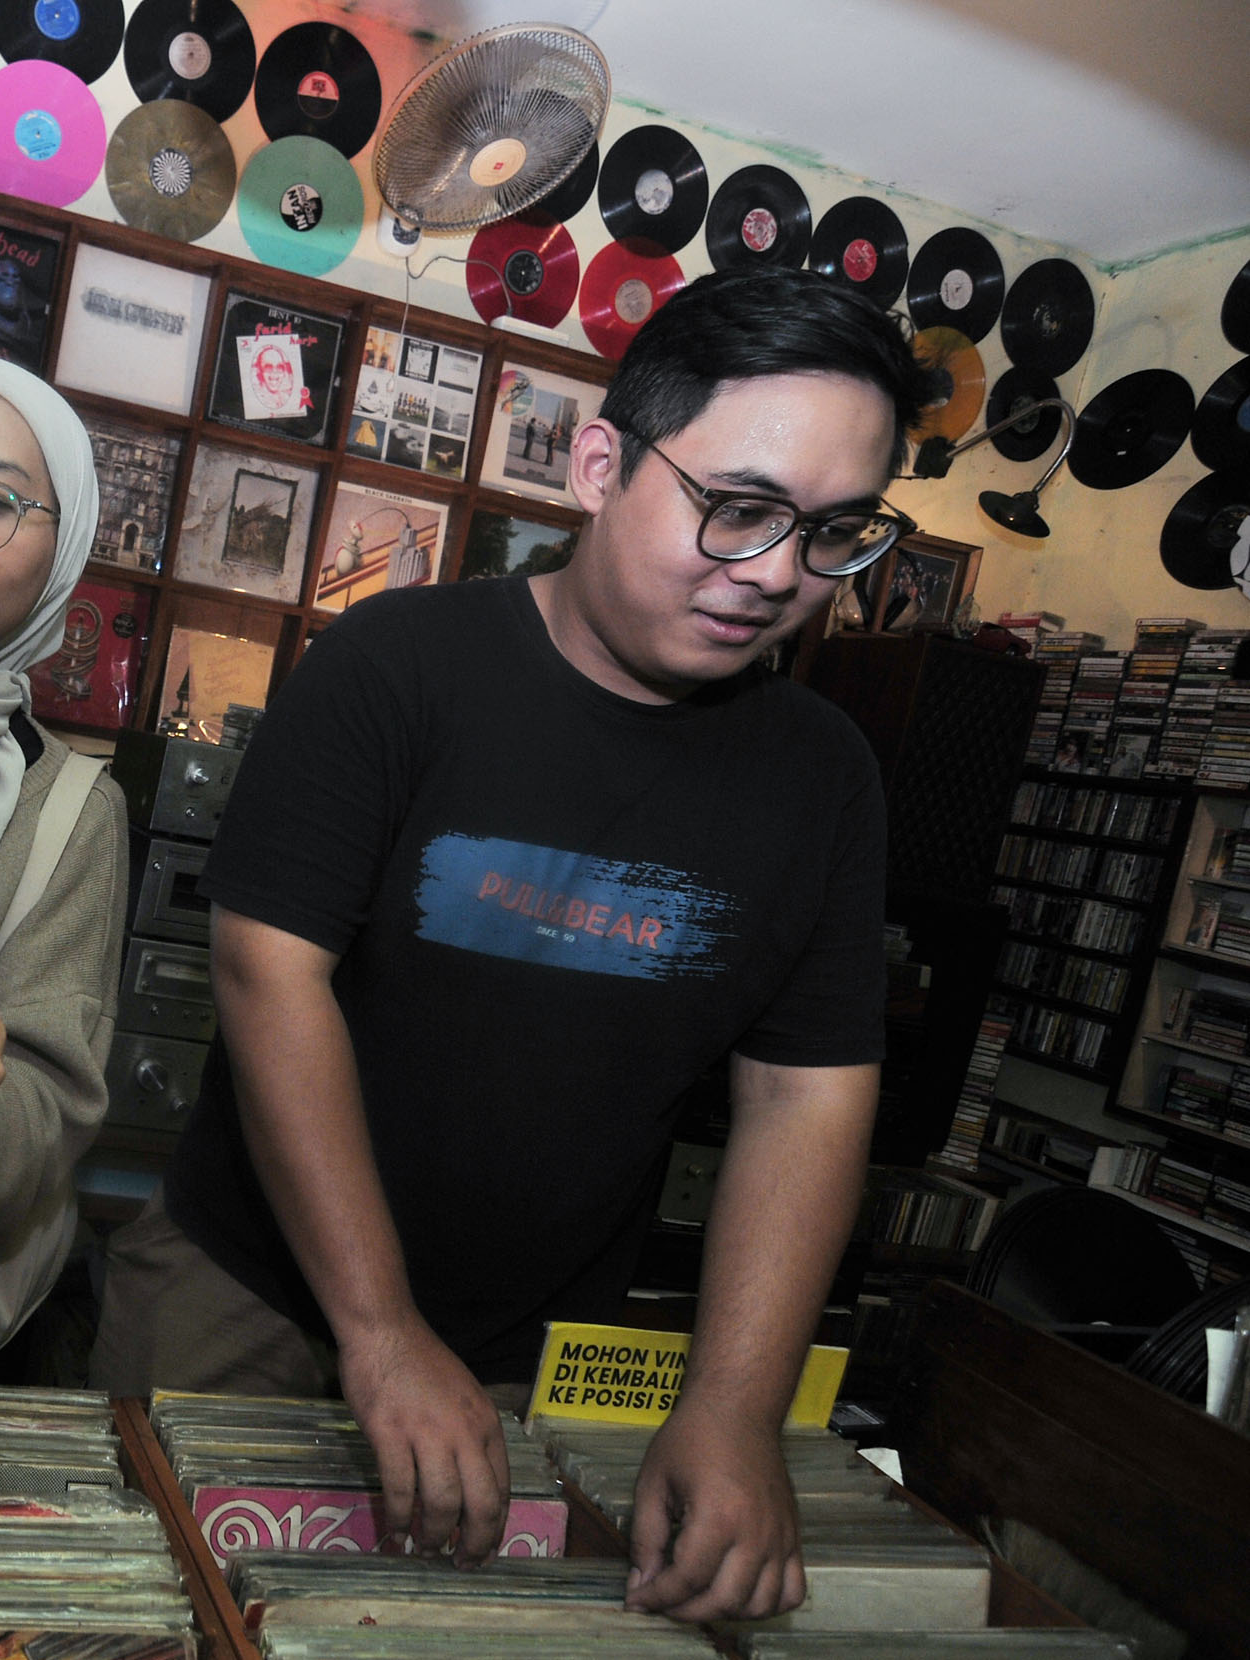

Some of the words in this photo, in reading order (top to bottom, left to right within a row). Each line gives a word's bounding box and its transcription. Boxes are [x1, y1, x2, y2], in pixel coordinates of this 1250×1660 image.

[478, 871, 664, 950] PULL&BEAR
[560, 1342, 649, 1366] MOHON
[554, 1363, 579, 1382] DI
[548, 1385, 578, 1404] KE
[581, 1388, 654, 1409] POSISI
